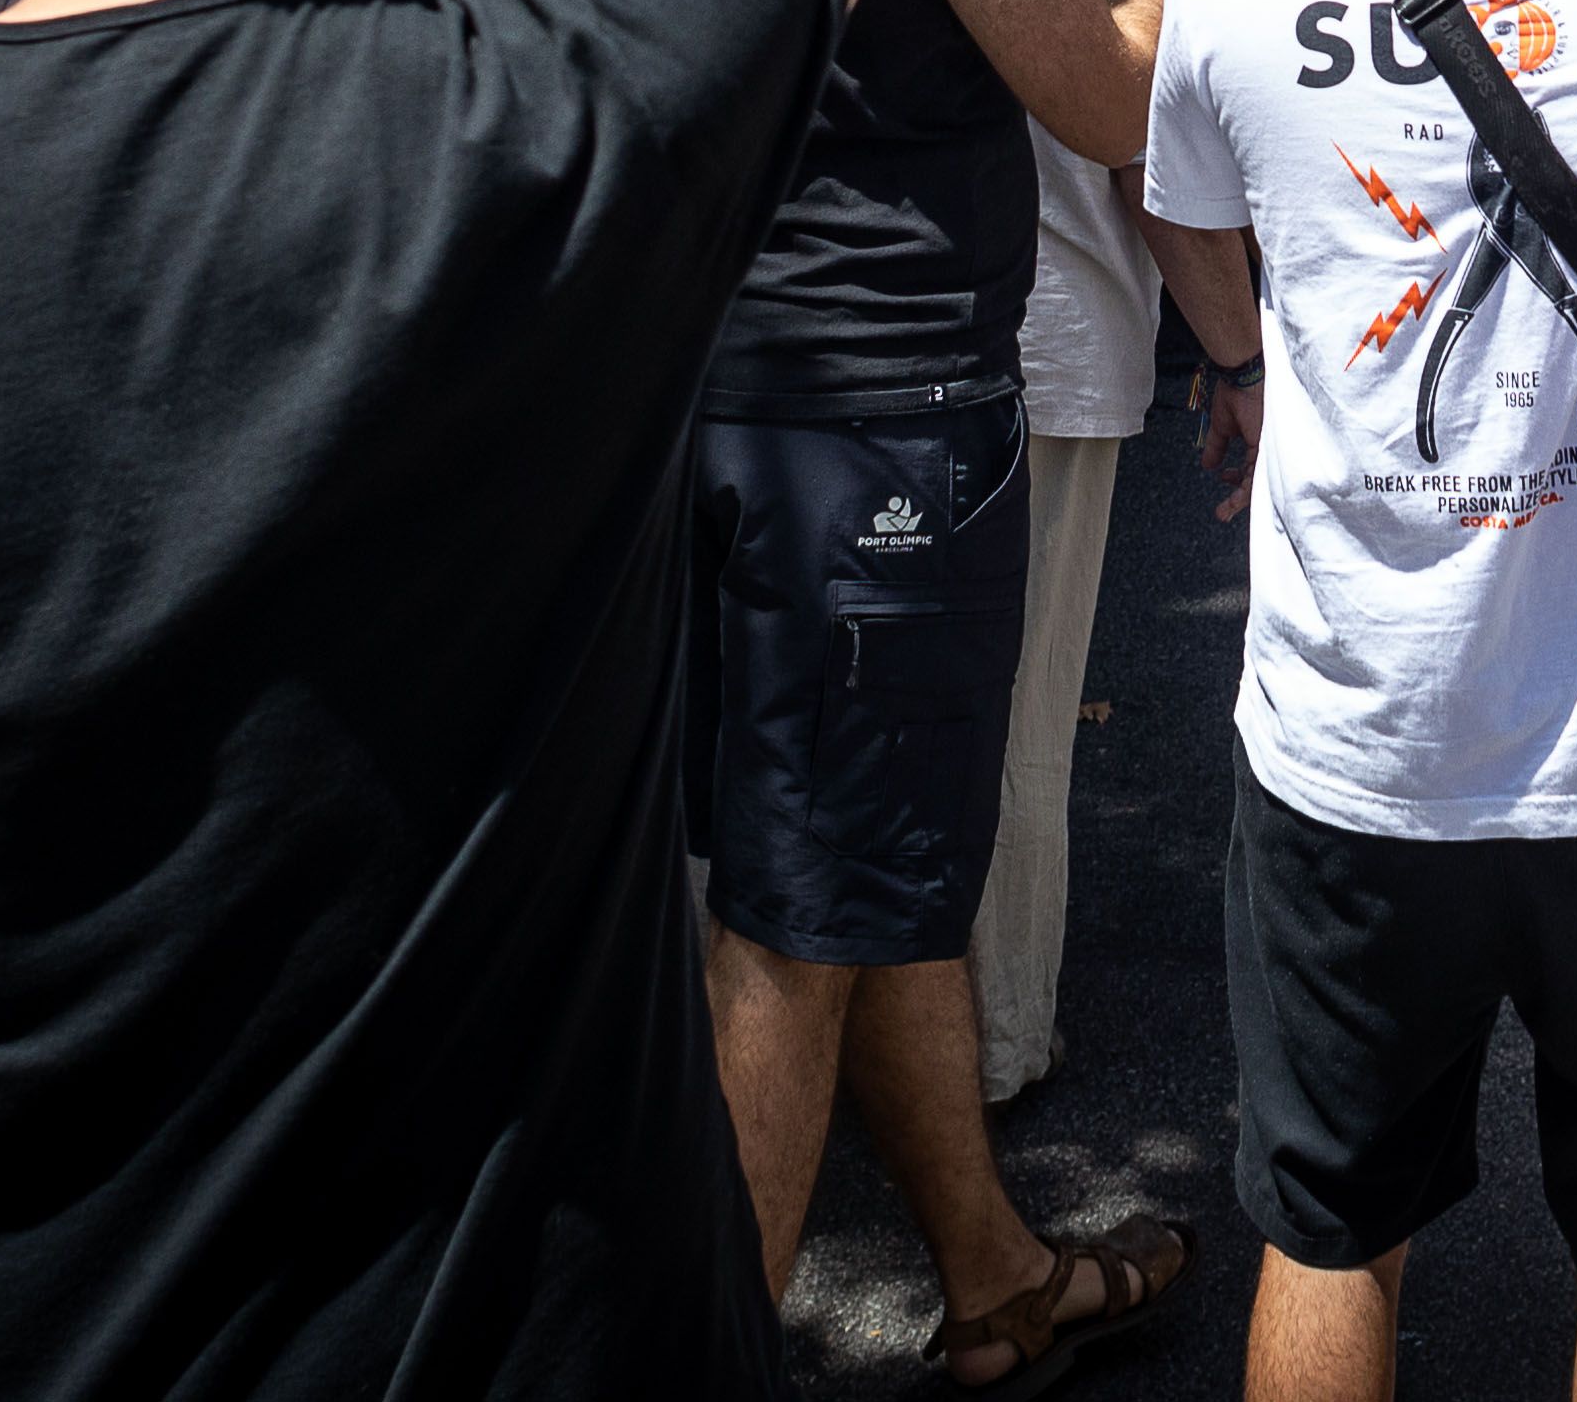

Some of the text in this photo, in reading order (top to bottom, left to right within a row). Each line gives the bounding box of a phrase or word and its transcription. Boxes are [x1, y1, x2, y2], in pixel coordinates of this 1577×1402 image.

[1403, 122, 1445, 142] RAD
[1495, 370, 1541, 390] SINCE
[1503, 390, 1535, 408] 1965
[1363, 473, 1417, 494] BREAK
[1421, 474, 1462, 494] FREE
[1468, 474, 1513, 494] FROM
[1518, 469, 1546, 492] THE
[1437, 488, 1540, 515] PERSONALIZE
[1459, 515, 1509, 531] COSTA
[857, 533, 933, 547] PORT OLÍMPIC
